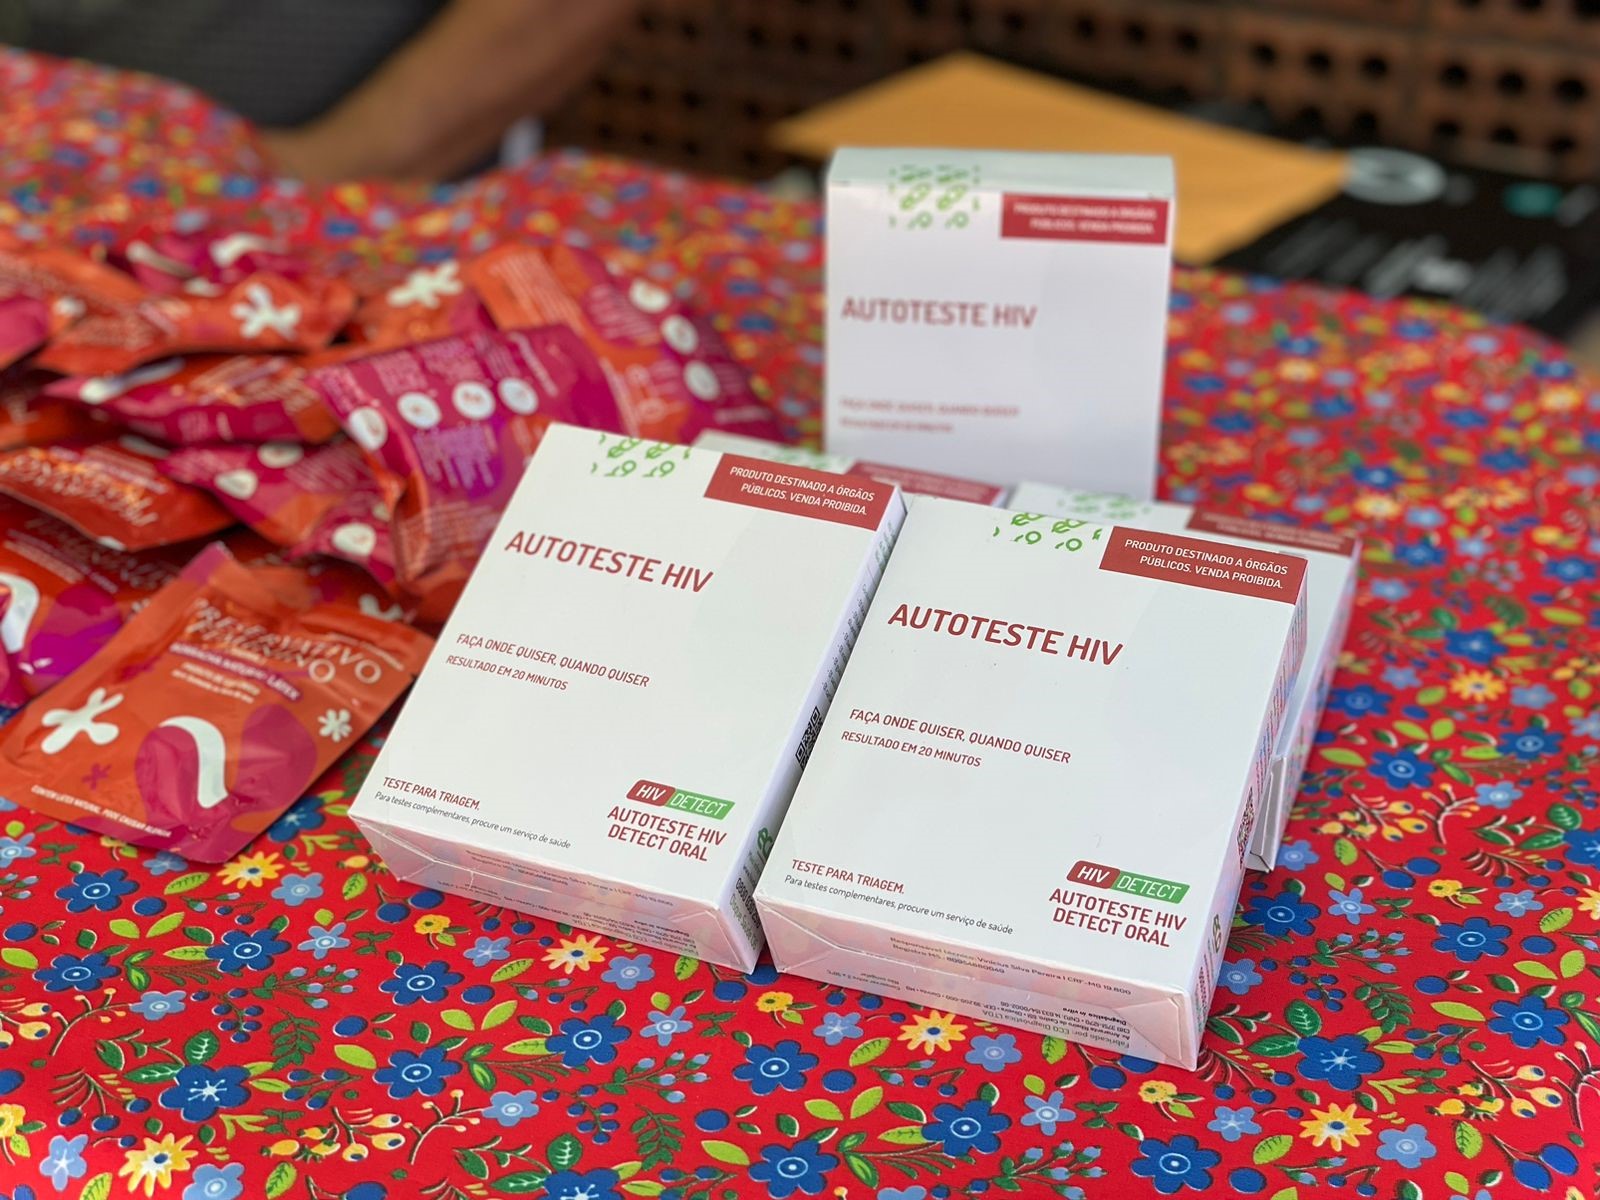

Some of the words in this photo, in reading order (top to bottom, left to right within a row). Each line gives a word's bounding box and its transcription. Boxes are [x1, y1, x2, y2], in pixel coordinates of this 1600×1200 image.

[841, 296, 987, 326] AUTOTESTE
[993, 305, 1037, 329] HIV
[729, 466, 774, 482] PRODUTO
[773, 474, 827, 492] DESTINADO
[826, 485, 834, 493] A
[835, 486, 875, 501] ÓRGÃOS
[790, 492, 821, 506] VENDA
[504, 530, 662, 582] AUTOTESTE
[661, 563, 714, 592] HIV
[1124, 539, 1174, 555] PRODUTO
[1174, 547, 1234, 565] DESTINADO
[1234, 558, 1243, 567] A
[1244, 559, 1288, 575] ÓRGÃOS
[1195, 565, 1230, 579] VENDA
[887, 603, 1064, 655] AUTOTESTE
[1066, 634, 1123, 665] HIV
[446, 655, 497, 673] RESULTADO
[496, 665, 513, 676] EM
[511, 669, 526, 680] 20
[525, 672, 568, 690] MINUTOS
[456, 633, 483, 648] FAÇA
[484, 639, 516, 655] ONDE
[559, 656, 607, 677] QUANDO
[607, 668, 650, 687] QUISER
[841, 730, 900, 750] RESULTADO
[900, 742, 918, 753] EM
[917, 745, 933, 757] 20
[933, 748, 982, 767] MINUTOS
[849, 708, 880, 724] FAÇA
[882, 714, 918, 731] ONDE
[968, 732, 1022, 752] QUANDO
[1023, 743, 1071, 764] QUISER
[383, 776, 413, 792] TESTE
[411, 784, 437, 799] PARA
[635, 784, 666, 801] HIV
[670, 792, 727, 816] DETECT
[374, 790, 391, 802] Para
[390, 795, 412, 808] testes
[470, 818, 499, 830] procure
[499, 825, 513, 833] um
[512, 828, 538, 841] serviço
[538, 833, 549, 843] de
[548, 838, 571, 849] saúde
[607, 805, 698, 839] AUTOTESTE
[697, 827, 727, 846] HIV
[607, 823, 669, 850] DETECT
[668, 839, 707, 862] ORAL
[792, 859, 825, 876] TESTE
[825, 866, 853, 882] PARA
[1077, 865, 1110, 883] HIV
[1116, 875, 1182, 899] DETECT
[784, 874, 803, 886] Para
[803, 879, 828, 892] testes
[897, 902, 930, 915] procure
[930, 910, 945, 918] um
[945, 913, 975, 926] serviço
[975, 919, 987, 928] de
[987, 923, 1013, 934] saúde
[1048, 888, 1153, 924] AUTOTESTE
[1154, 911, 1187, 931] HIV
[1052, 907, 1123, 935] DETECT
[1124, 924, 1169, 947] ORAL
